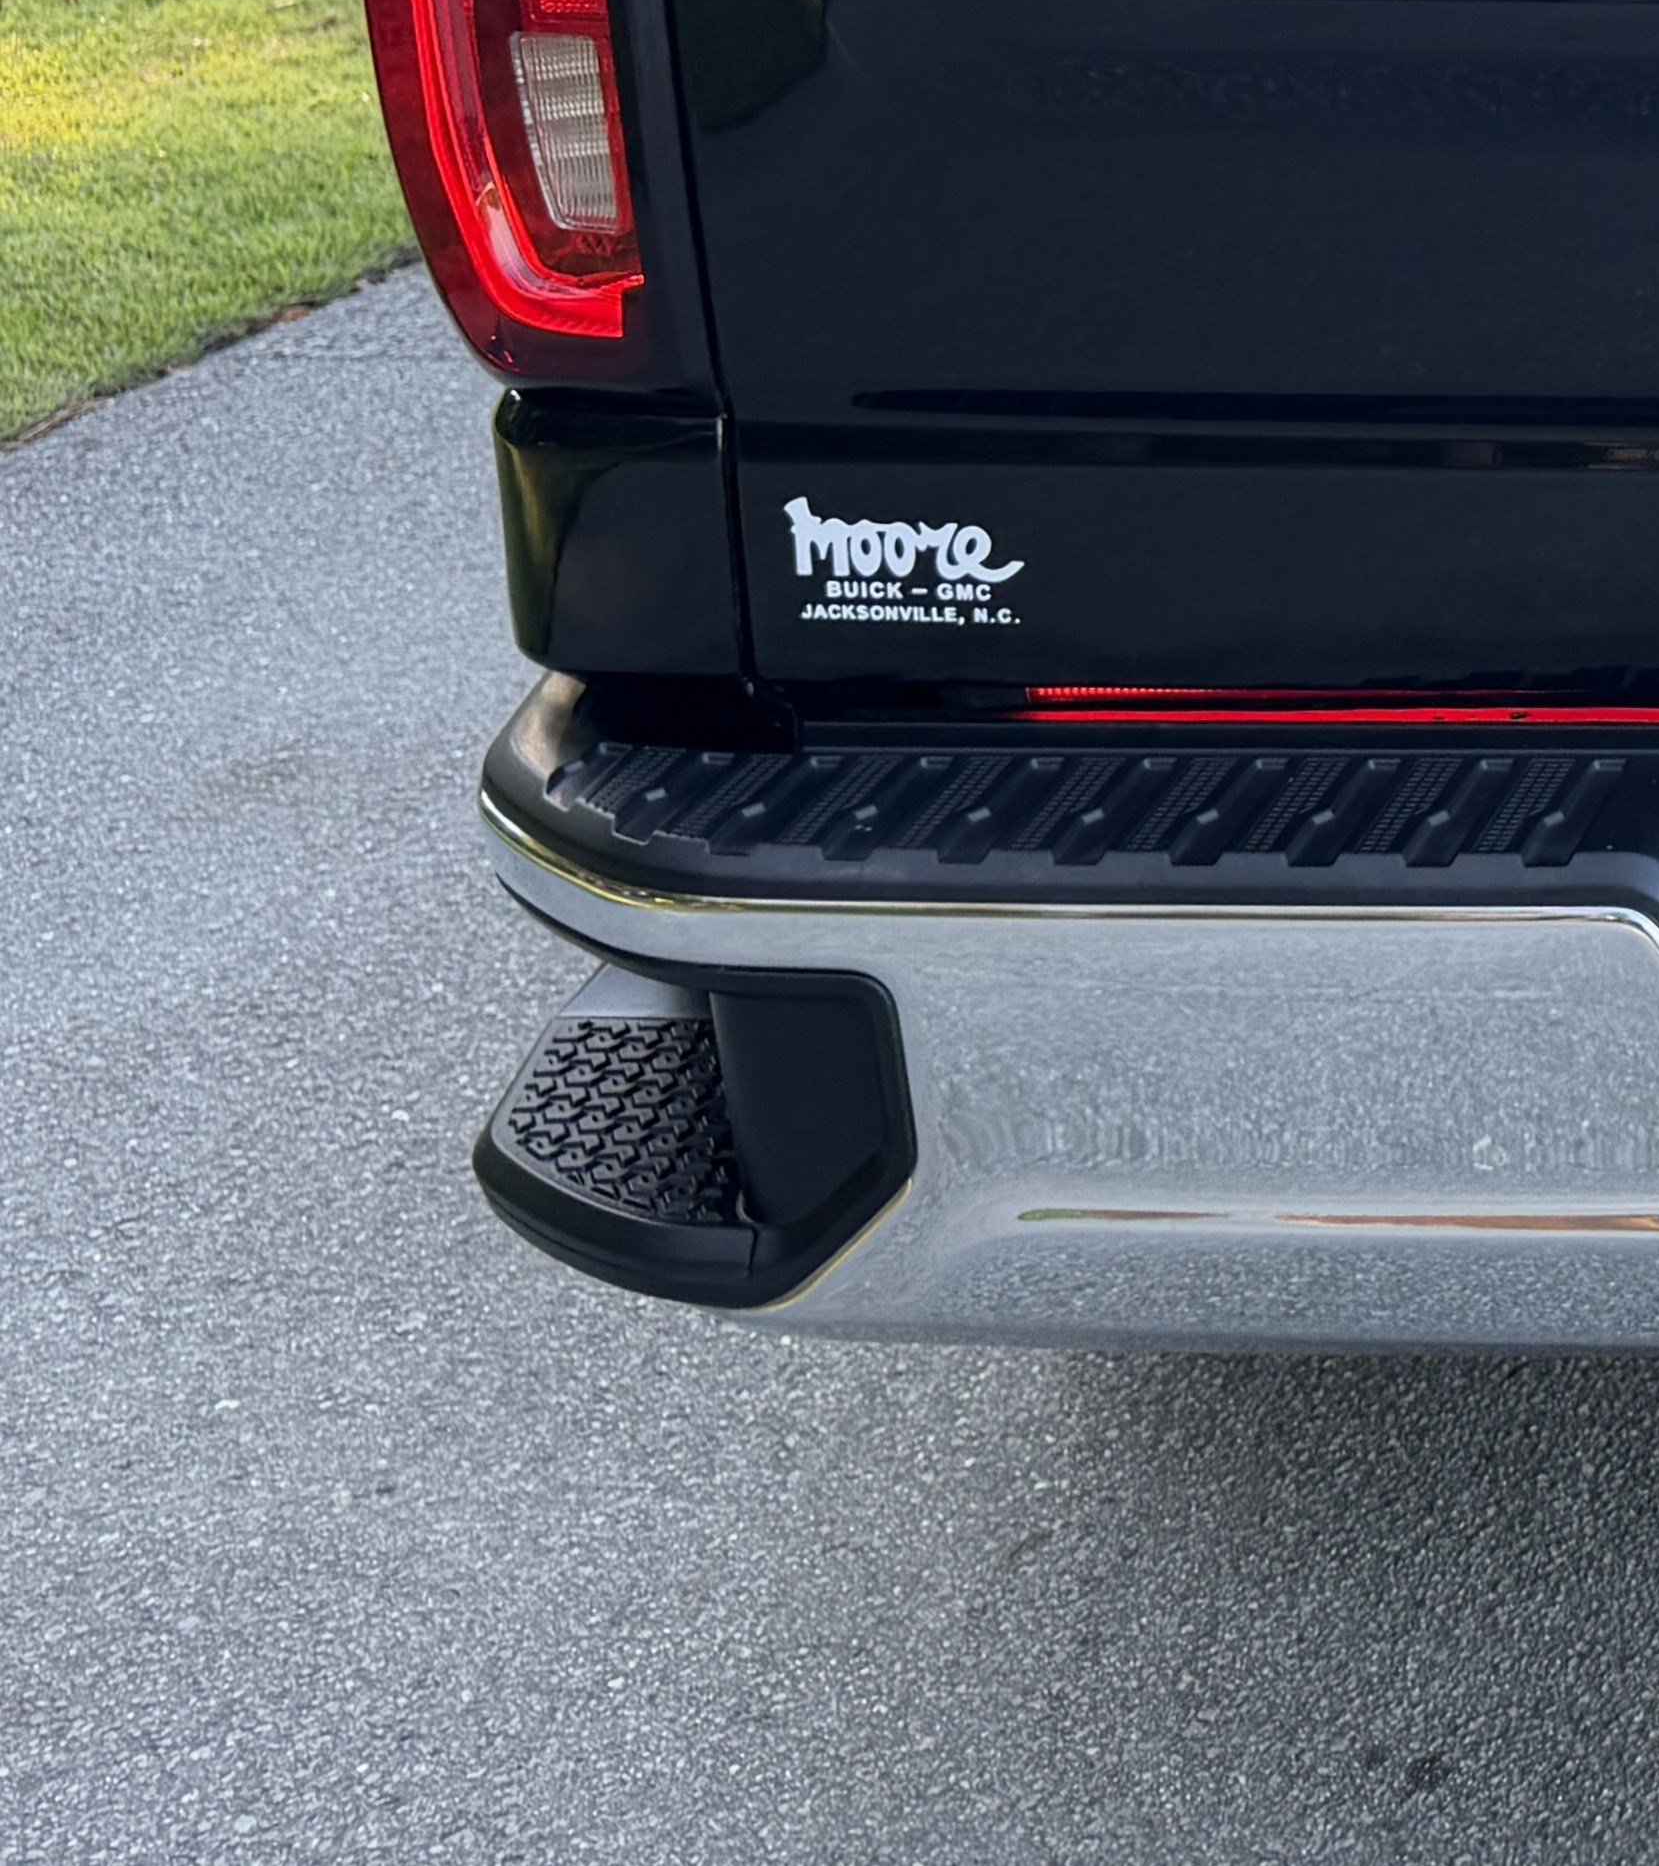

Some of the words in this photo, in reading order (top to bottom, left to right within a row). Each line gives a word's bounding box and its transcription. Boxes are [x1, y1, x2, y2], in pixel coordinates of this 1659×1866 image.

[825, 580, 904, 600] BUICK
[936, 583, 992, 601] GMC
[800, 603, 966, 626] JACKSONVILLE,
[973, 607, 1022, 625] N.C.
